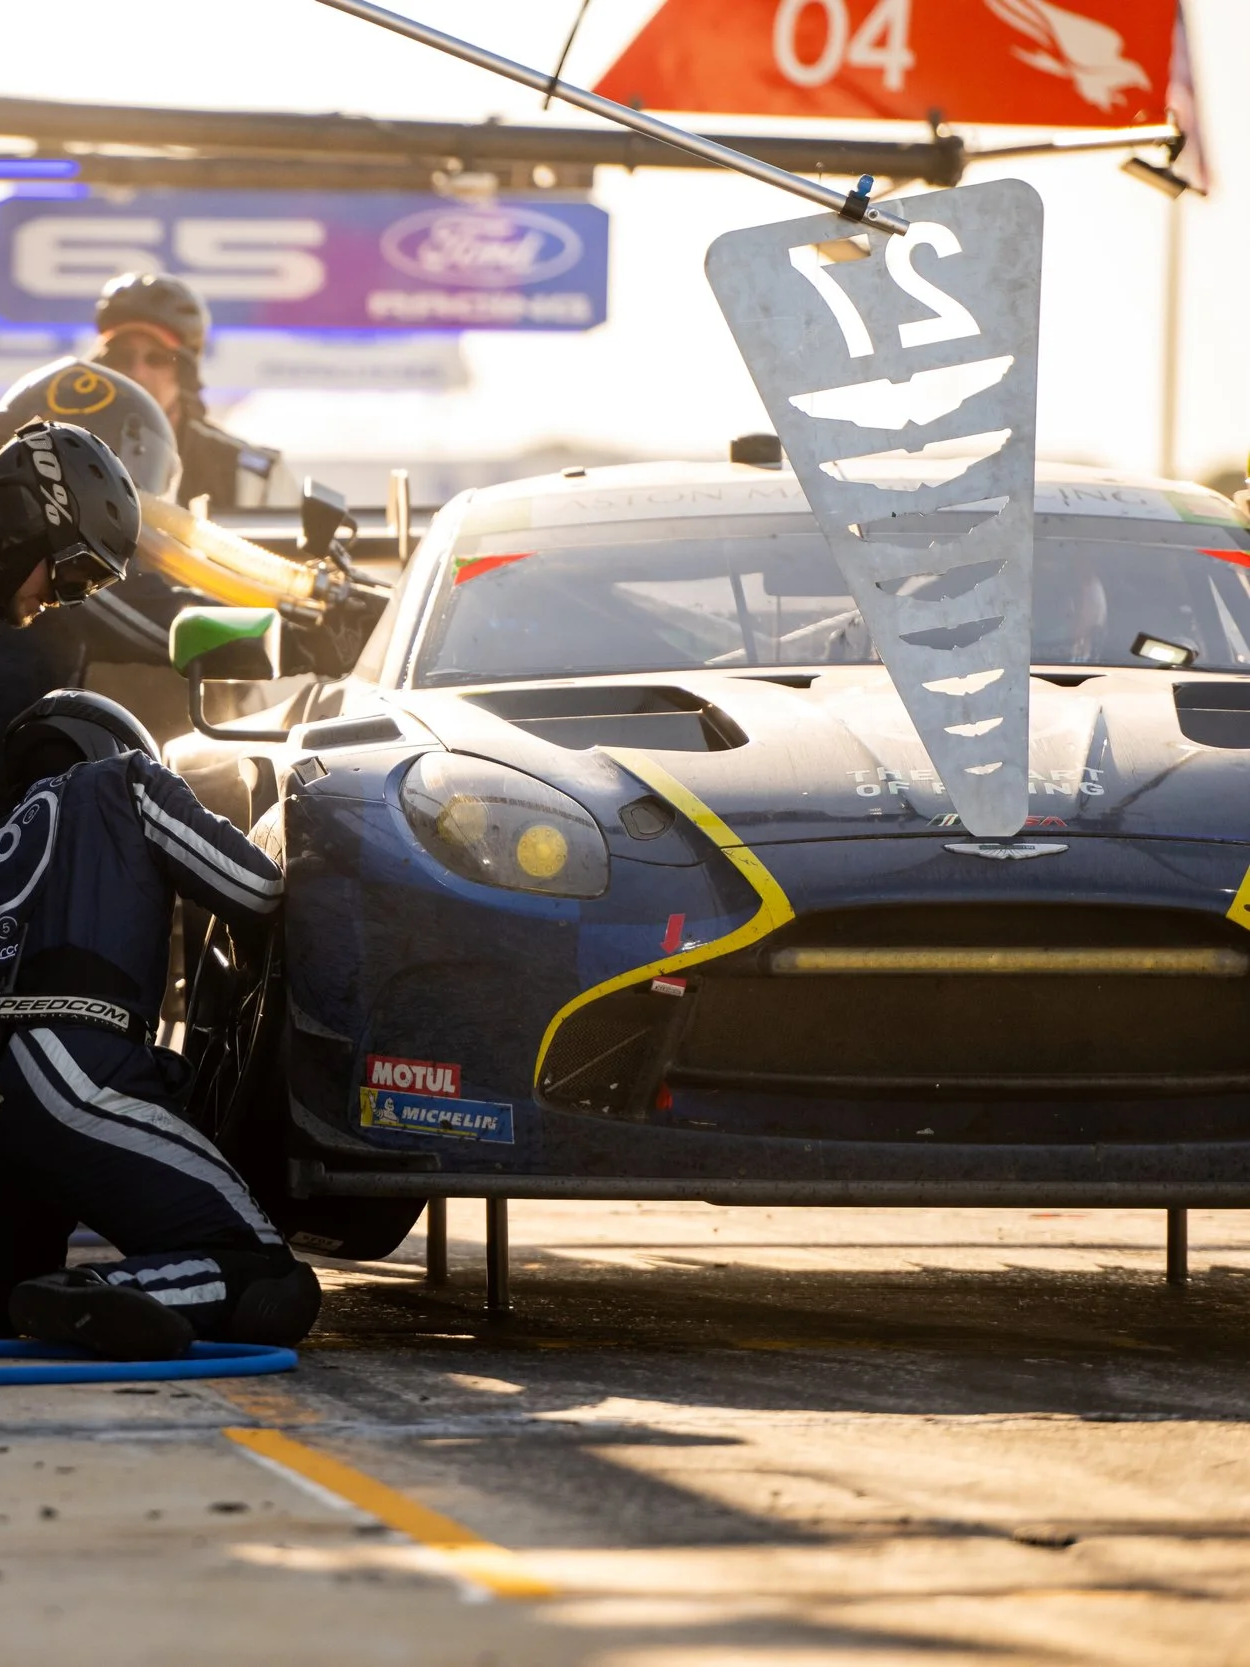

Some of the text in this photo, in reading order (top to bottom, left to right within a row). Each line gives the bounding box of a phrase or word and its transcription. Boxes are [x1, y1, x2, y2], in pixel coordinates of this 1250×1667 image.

[773, 0, 916, 91] 04
[13, 217, 326, 301] 65
[417, 217, 545, 275] Ford
[23, 431, 73, 526] 00%
[561, 487, 723, 512] ASTON
[847, 766, 1104, 783] THE ART
[856, 781, 910, 798] OF
[2, 922, 11, 934] 5
[372, 1061, 455, 1093] MOTUL
[402, 1106, 499, 1130] MICHELIN
